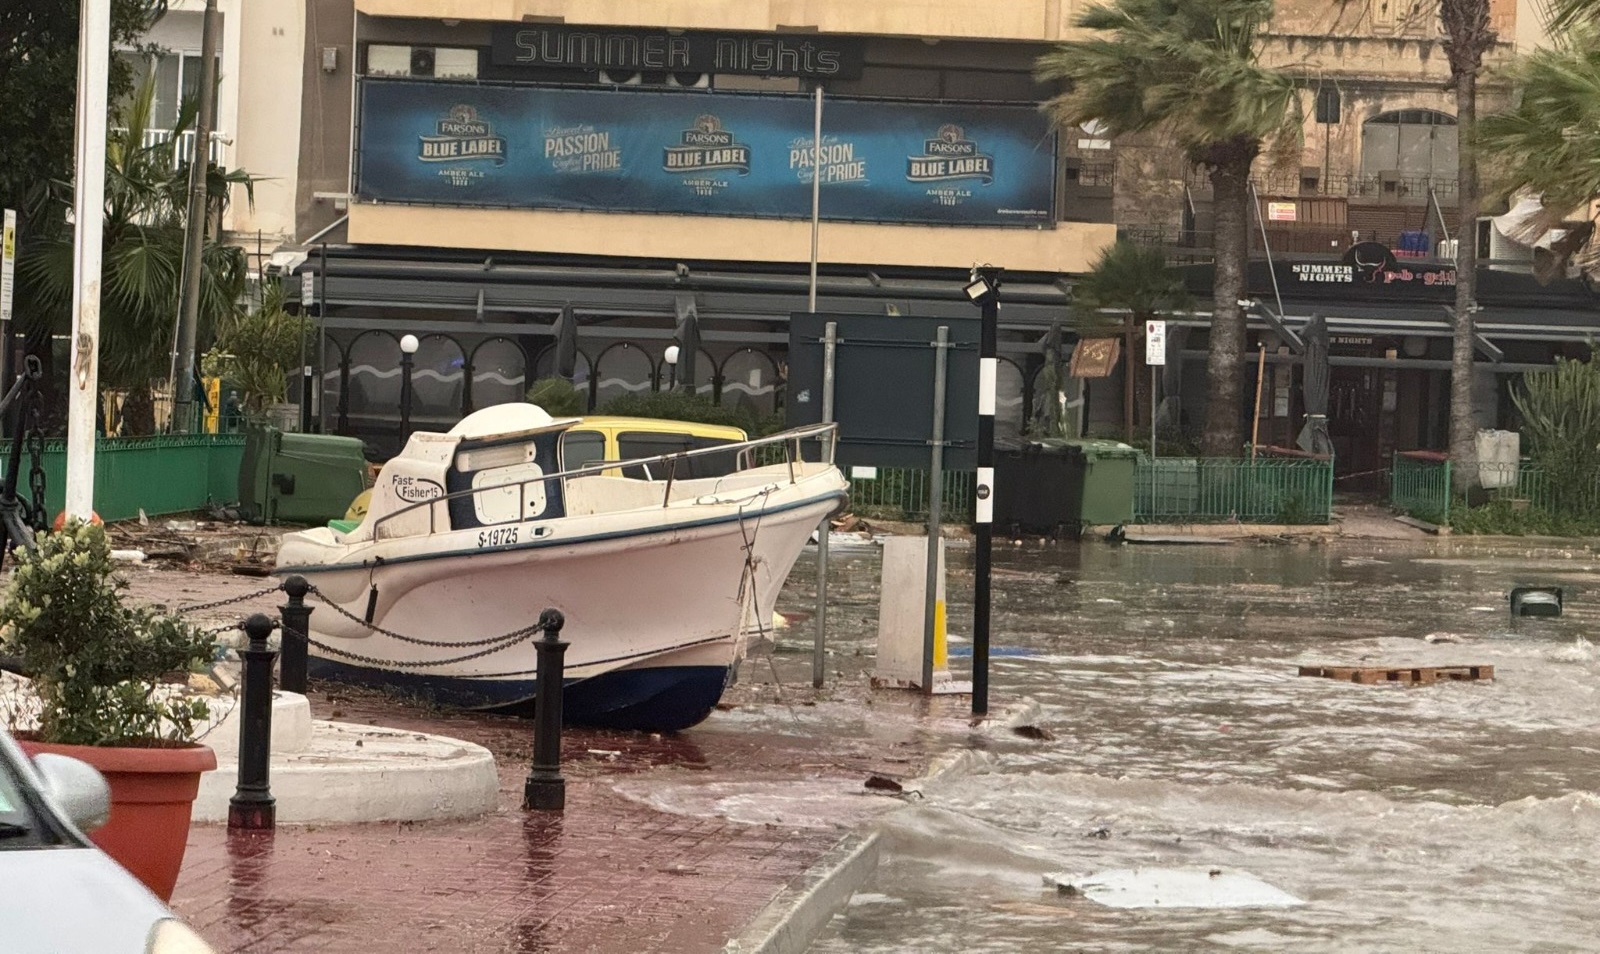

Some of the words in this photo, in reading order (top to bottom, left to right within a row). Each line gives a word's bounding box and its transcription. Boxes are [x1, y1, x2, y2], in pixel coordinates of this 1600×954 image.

[515, 30, 690, 67] SUMMER
[442, 122, 485, 134] FARSONS
[685, 132, 729, 143] FARSONS
[423, 142, 458, 156] BLUE
[461, 140, 503, 155] LABEL
[545, 131, 609, 158] PASSION
[929, 142, 972, 153] FARSONS
[583, 150, 621, 171] PRIDE
[667, 152, 702, 167] BLUE
[705, 149, 747, 164] LABEL
[790, 143, 853, 169] PASSION
[438, 169, 467, 177] AMBER
[827, 161, 865, 182] PRIDE
[911, 162, 945, 176] BLUE
[948, 159, 990, 174] LABEL
[682, 179, 711, 187] AMBER
[926, 189, 955, 197] AMBER
[1292, 264, 1353, 274] SUMMER
[1299, 273, 1353, 282] NIGHTS
[1338, 337, 1373, 345] NIGHTS
[392, 474, 414, 486] Fast
[478, 527, 518, 547] S-19725
